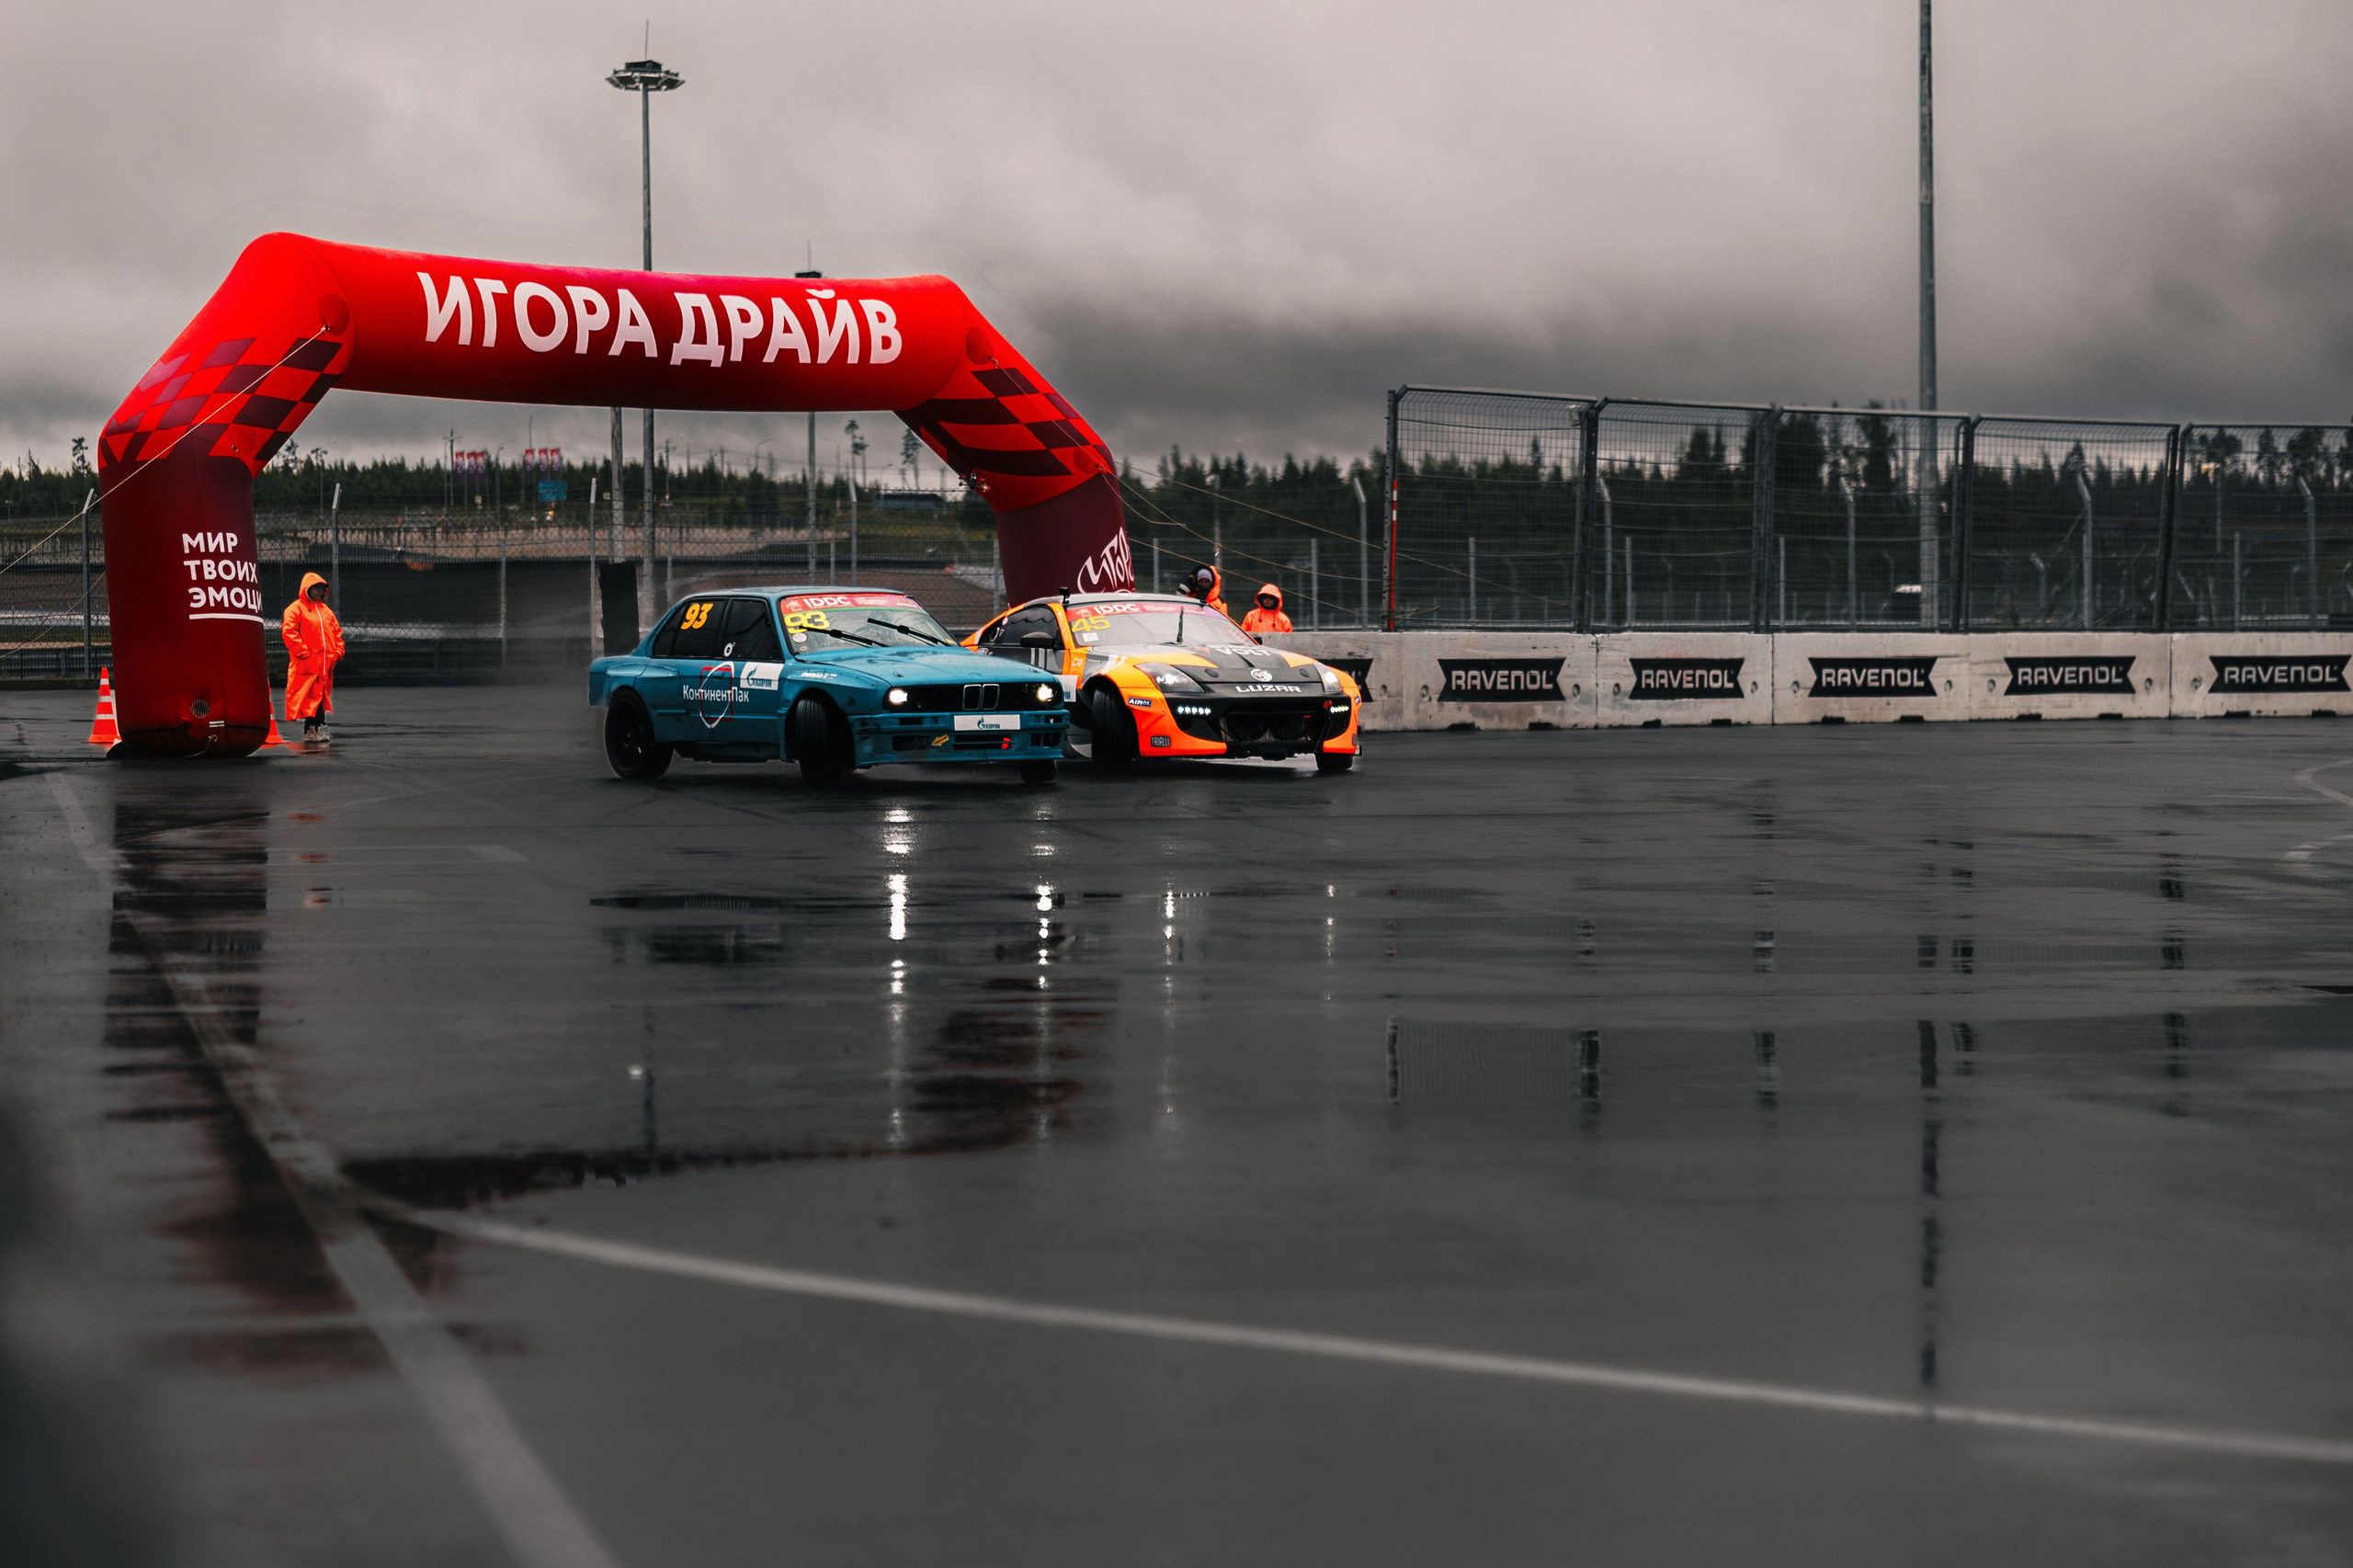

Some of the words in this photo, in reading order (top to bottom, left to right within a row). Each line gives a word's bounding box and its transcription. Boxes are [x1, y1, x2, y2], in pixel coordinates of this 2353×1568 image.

[416, 272, 658, 358] ИГОРА
[670, 289, 903, 368] ДРАЙВ
[182, 532, 238, 554] МИР
[183, 559, 258, 585] ТВОИХ
[803, 597, 851, 608] IDDC
[1093, 603, 1141, 615] IDDC
[681, 603, 714, 630] 93
[784, 611, 830, 634] 93
[1072, 616, 1110, 632] 45
[1216, 647, 1271, 656] VOLT
[1451, 670, 1553, 690] RAVENOL
[1642, 670, 1734, 688] RAVENOL
[1822, 668, 1925, 687] RAVENOL
[2018, 666, 2123, 686] RAVENOL
[2224, 665, 2338, 684] RAVENOL
[683, 685, 750, 702] КонтинентПак
[1151, 736, 1170, 747] TRIALLI
